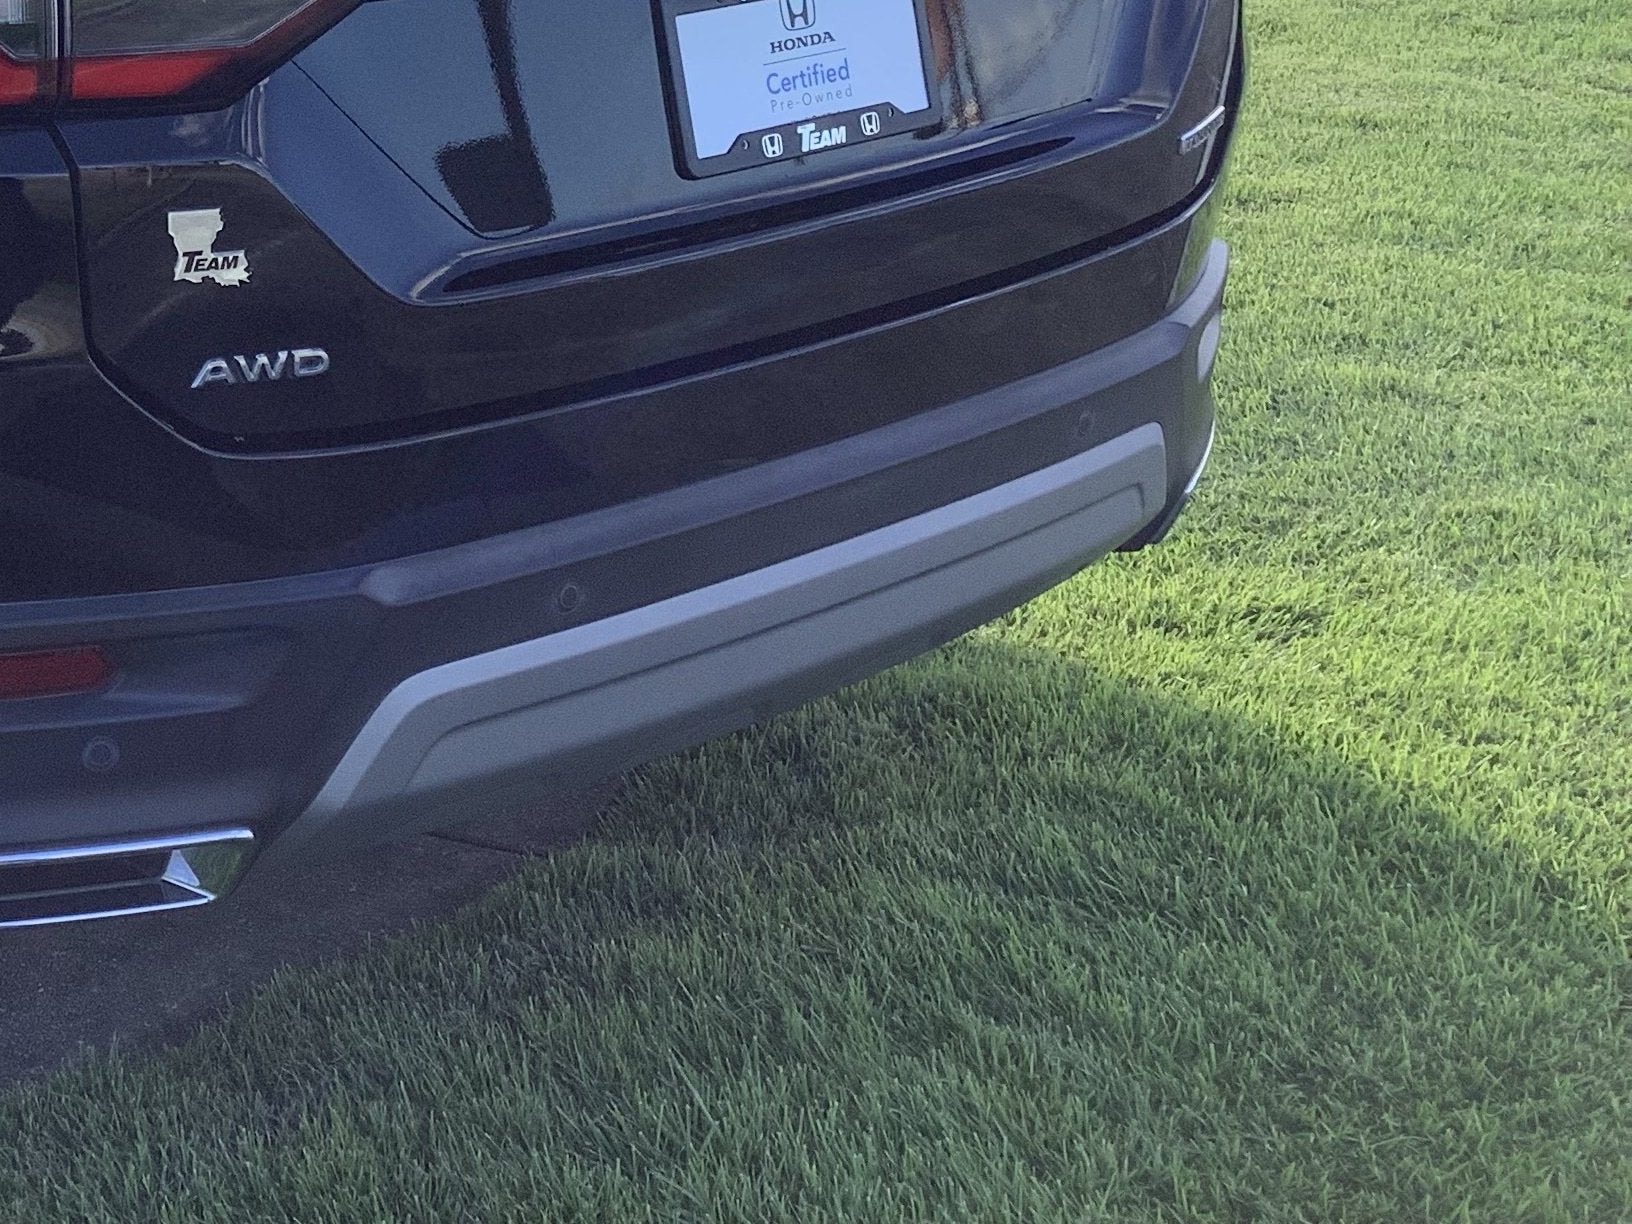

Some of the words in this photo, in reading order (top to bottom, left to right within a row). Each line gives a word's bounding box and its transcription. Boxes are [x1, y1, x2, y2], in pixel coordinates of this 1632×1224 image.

[769, 31, 836, 53] HONDA
[766, 58, 851, 95] Certified
[770, 85, 854, 112] Pre-Owned
[797, 123, 847, 153] TEAM
[182, 250, 239, 273] TEAM
[190, 347, 330, 389] AWD
